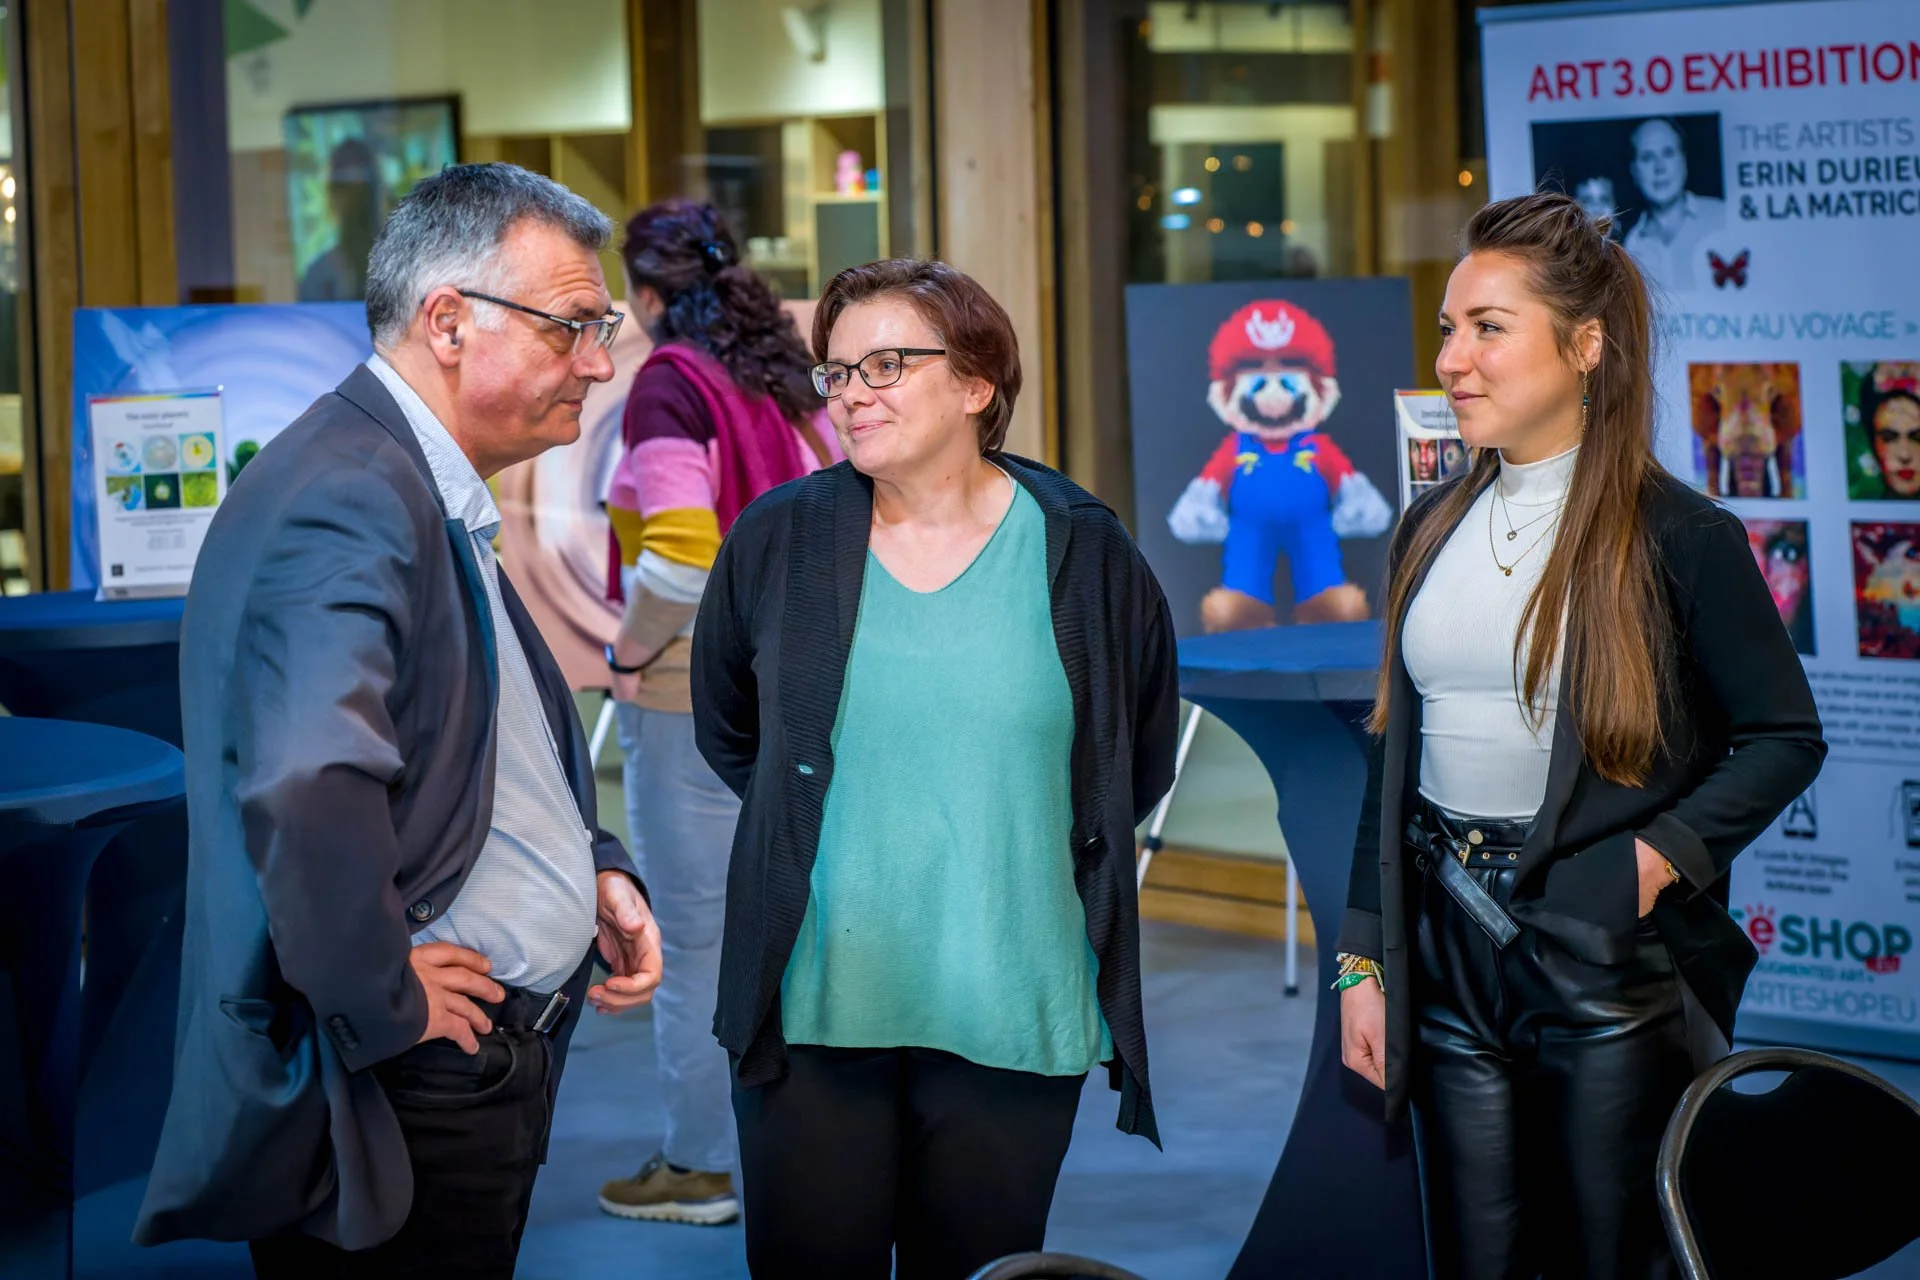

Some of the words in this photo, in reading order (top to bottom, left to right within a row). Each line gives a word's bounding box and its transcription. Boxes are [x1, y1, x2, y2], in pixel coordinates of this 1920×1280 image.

[1528, 61, 1606, 102] ART
[1611, 55, 1674, 97] 3.0
[1735, 122, 1791, 151] THE
[1797, 117, 1916, 149] ARTISTS
[1737, 160, 1807, 188] ERIN
[1739, 194, 1758, 220] &
[1767, 193, 1802, 220] LA
[1806, 188, 1920, 219] MATRIC
[1662, 311, 1744, 341] ATION
[1747, 311, 1786, 340] AU
[1789, 310, 1896, 340] VOYAGE
[1728, 904, 1912, 962] eSHOP
